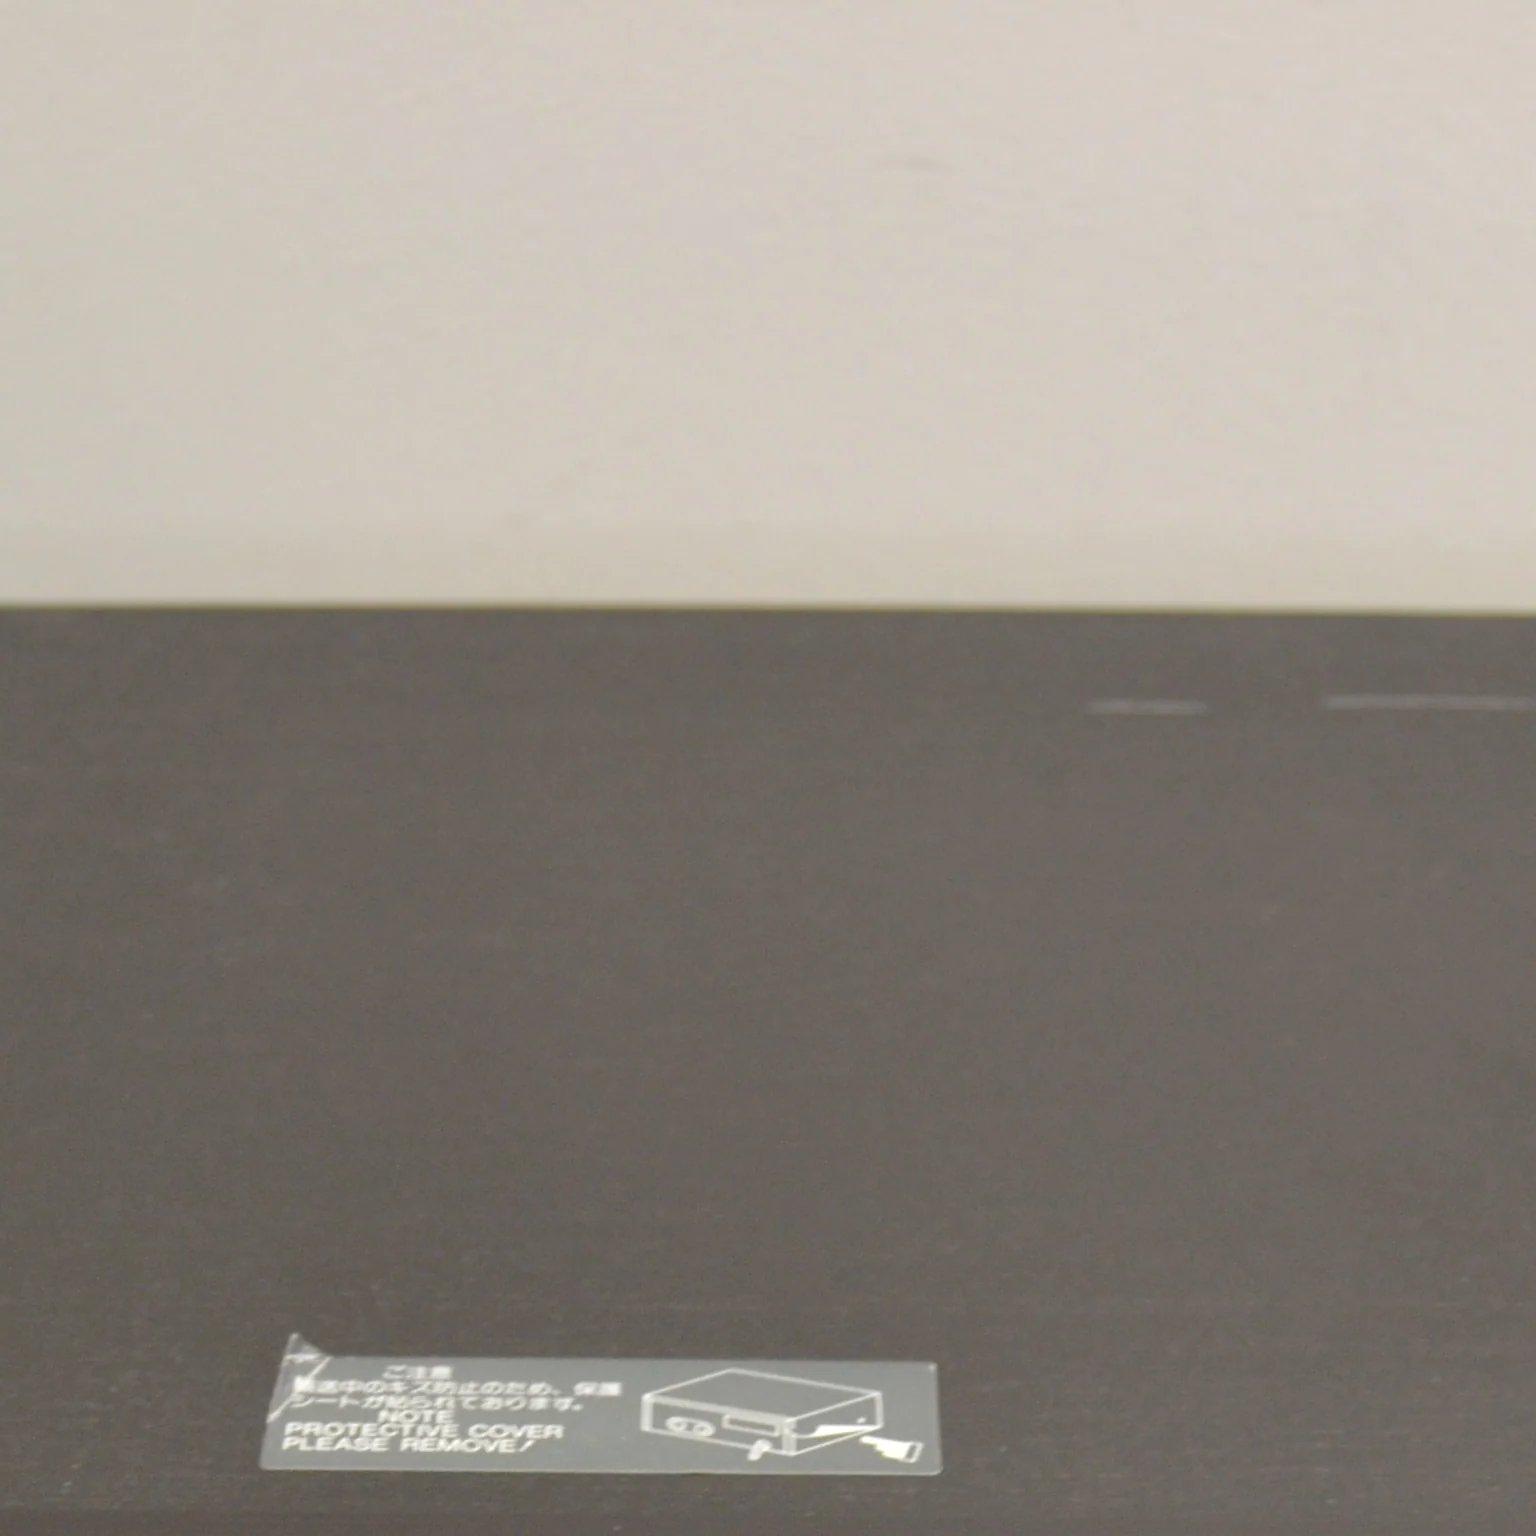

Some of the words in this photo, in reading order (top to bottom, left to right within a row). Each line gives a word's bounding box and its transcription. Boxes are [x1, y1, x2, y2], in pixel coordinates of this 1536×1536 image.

[378, 1409, 454, 1425] NOTE
[284, 1421, 460, 1438] PROTECTIVE
[468, 1424, 566, 1440] COVER
[282, 1436, 389, 1452] PLEASE
